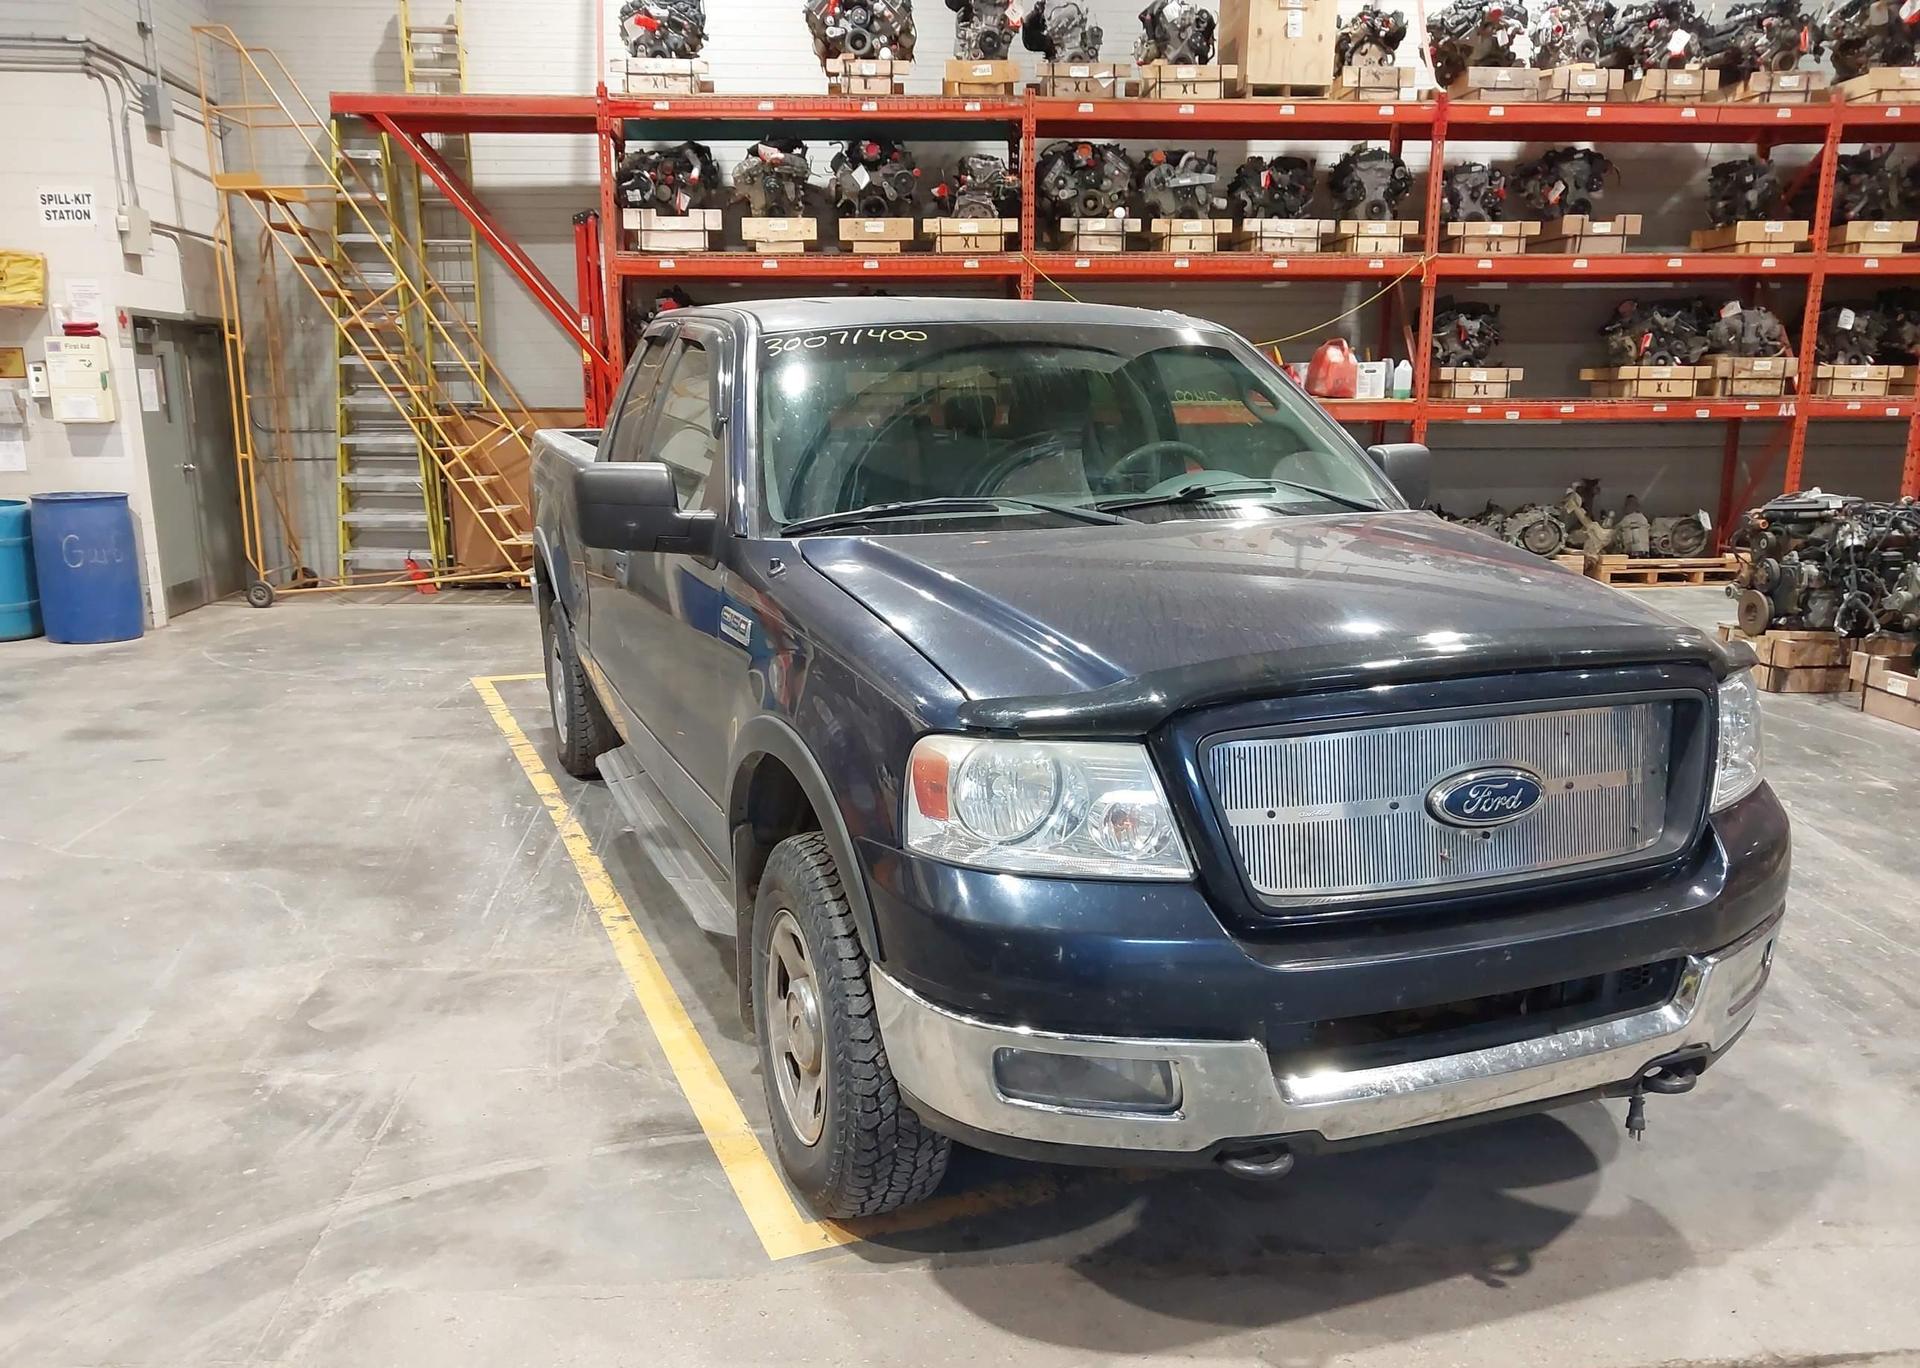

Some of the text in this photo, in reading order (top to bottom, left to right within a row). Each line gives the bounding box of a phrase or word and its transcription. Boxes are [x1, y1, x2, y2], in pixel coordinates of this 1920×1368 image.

[40, 193, 92, 205] SPILL-KIT
[45, 209, 91, 221] STATION
[764, 329, 928, 357] 30071400
[1463, 782, 1524, 814] Ford
